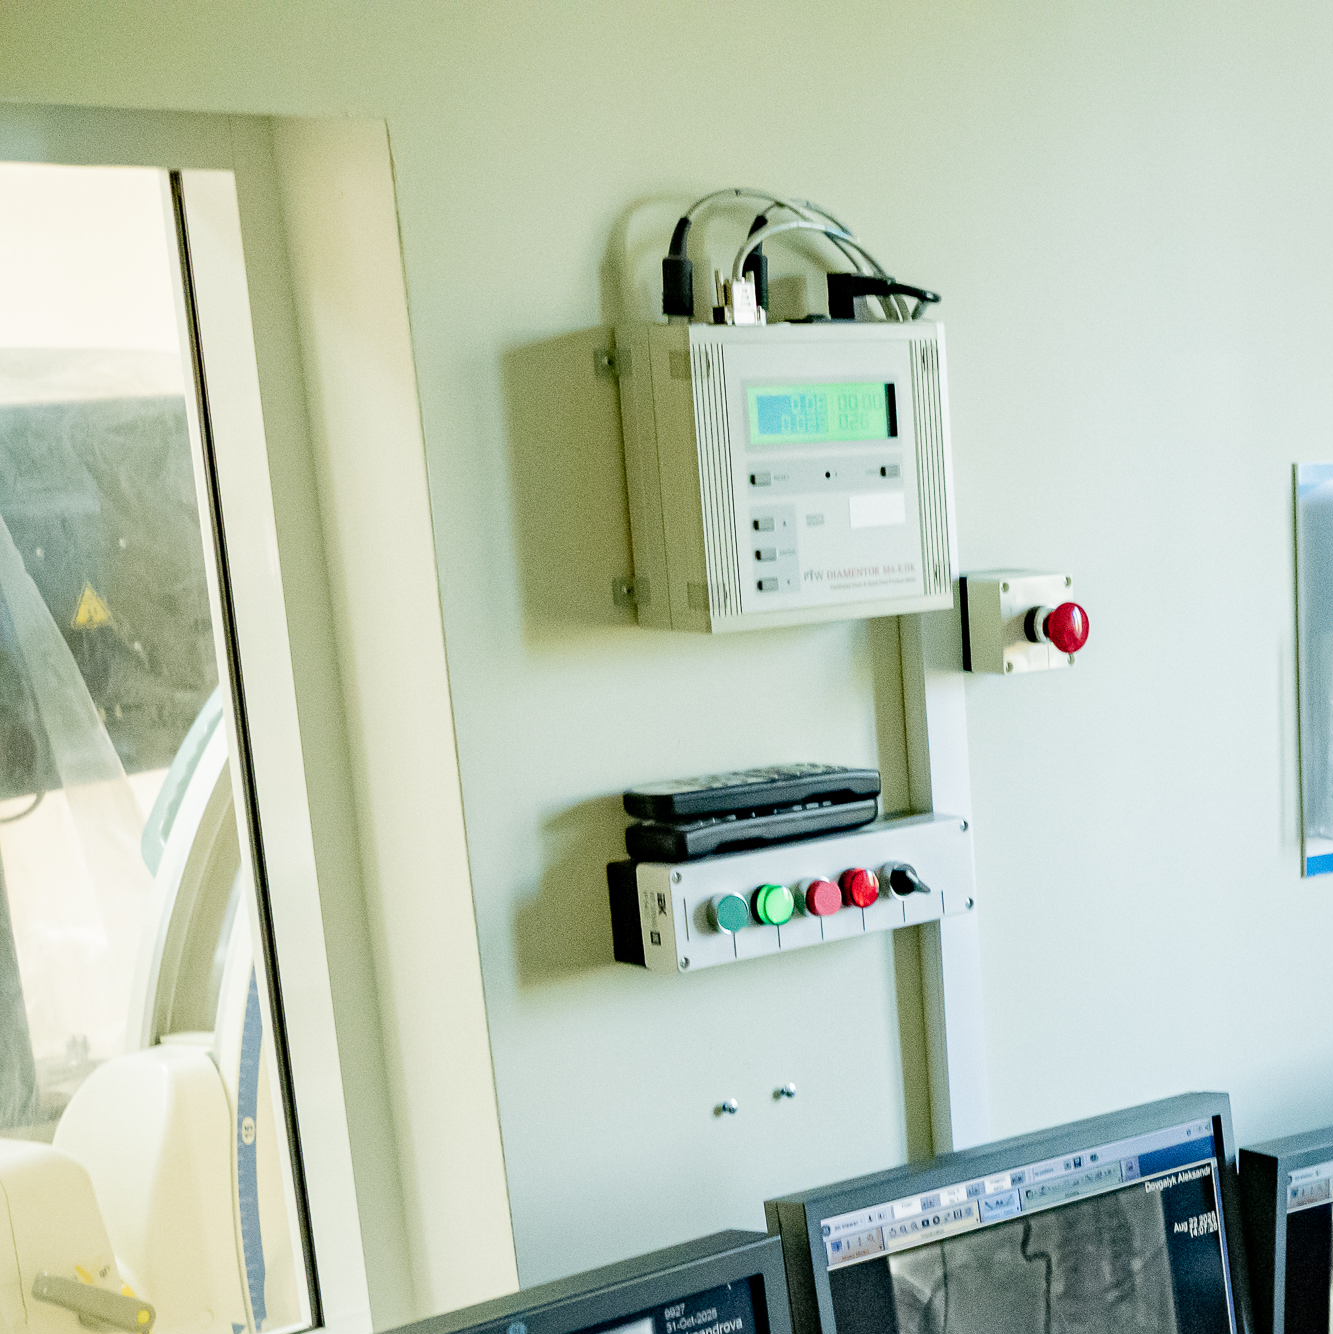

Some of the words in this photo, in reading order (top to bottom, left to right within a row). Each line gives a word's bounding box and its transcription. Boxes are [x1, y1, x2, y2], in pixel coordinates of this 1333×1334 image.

[826, 567, 880, 580] DIAMENTOR
[1145, 1175, 1177, 1193] Dovgalyk
[1174, 1221, 1188, 1233] Aug
